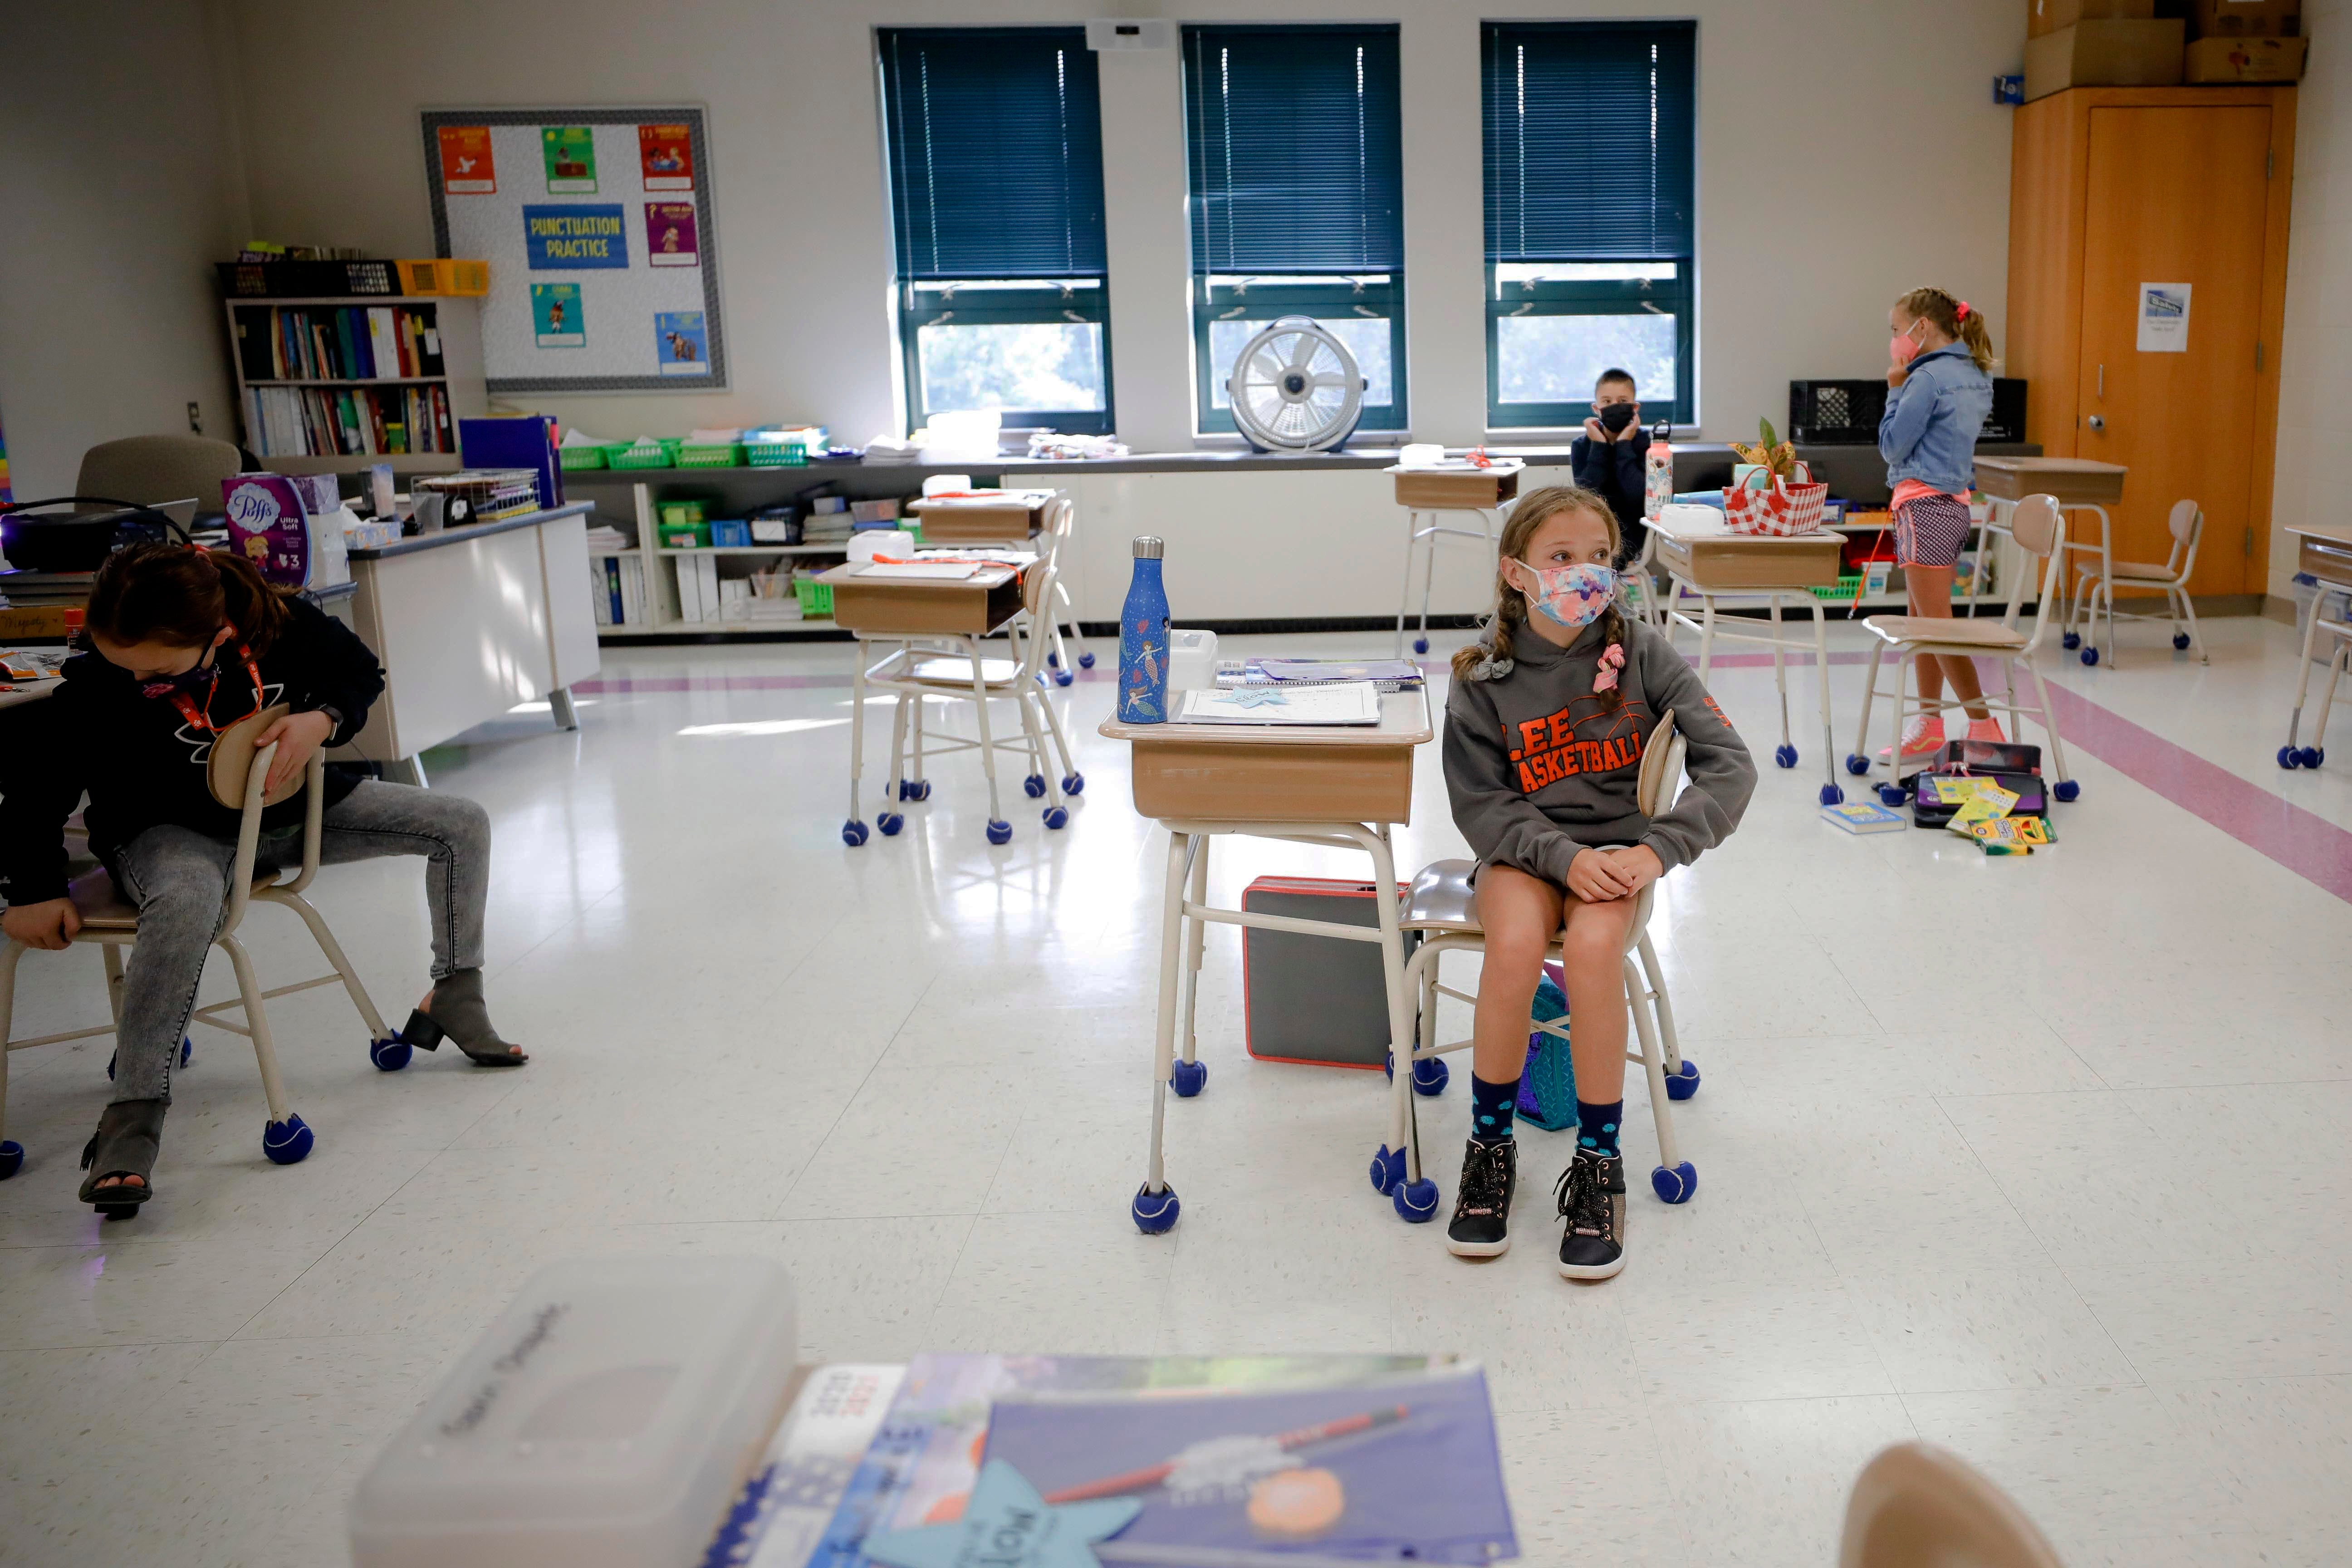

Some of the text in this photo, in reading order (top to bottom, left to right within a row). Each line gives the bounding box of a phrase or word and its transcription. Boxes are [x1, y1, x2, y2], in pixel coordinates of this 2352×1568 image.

[531, 217, 620, 236] PUNCTUATION
[546, 239, 608, 259] PRACTICE
[234, 495, 272, 523] Puffs
[291, 554, 299, 567] 3
[1515, 731, 1645, 794] ASKETBALL
